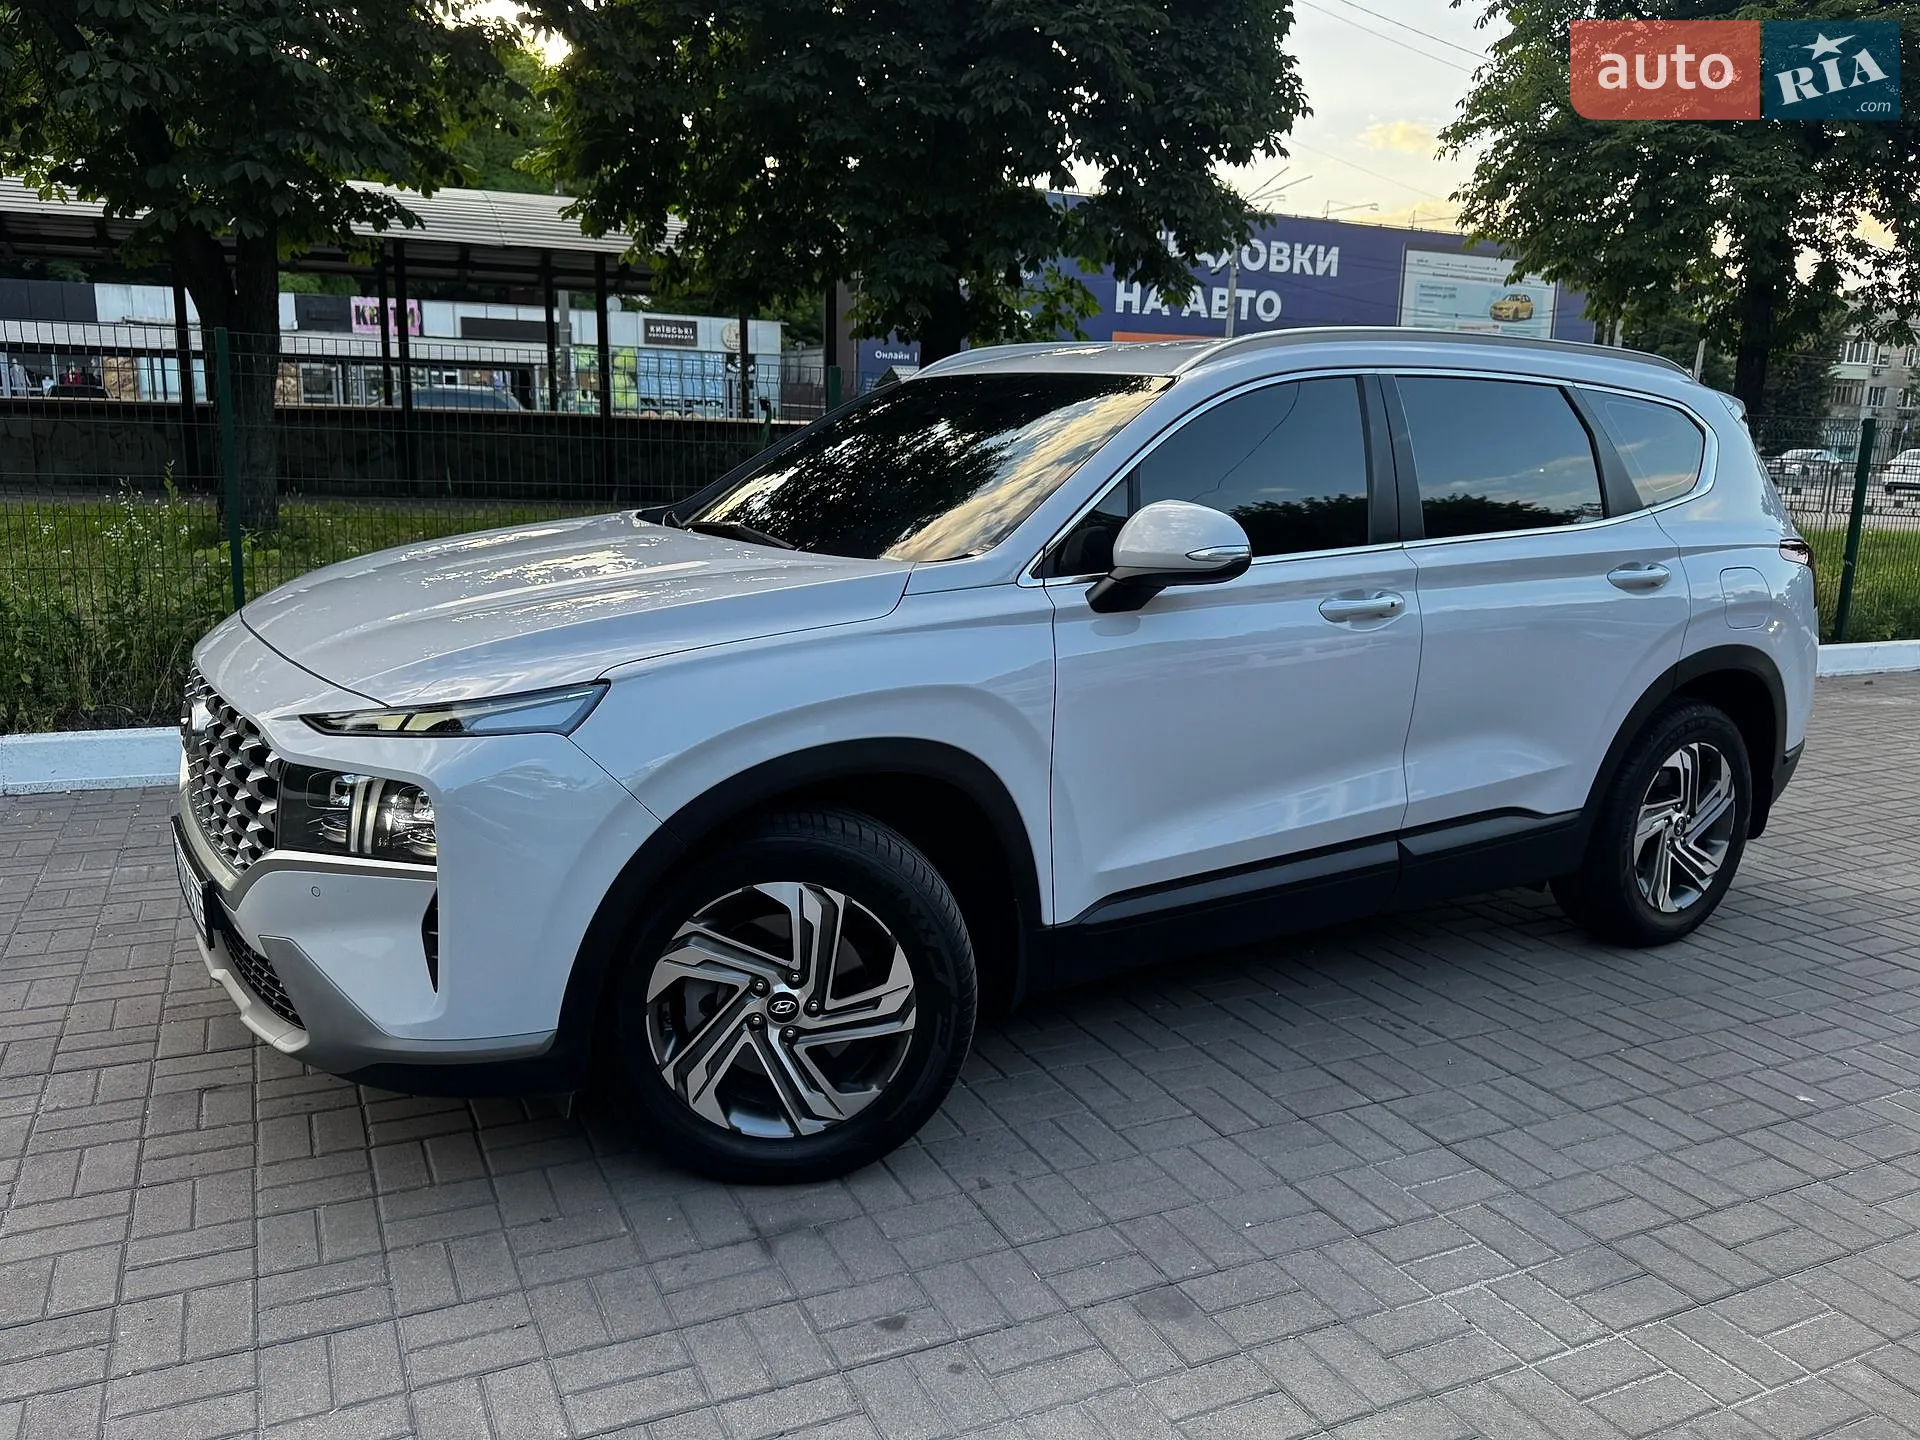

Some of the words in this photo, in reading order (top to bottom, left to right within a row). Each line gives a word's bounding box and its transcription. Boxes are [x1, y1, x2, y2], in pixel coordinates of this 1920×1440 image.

[1115, 279, 1170, 316] НА
[1181, 284, 1282, 322] АВТО
[875, 350, 910, 360] Онлайн
